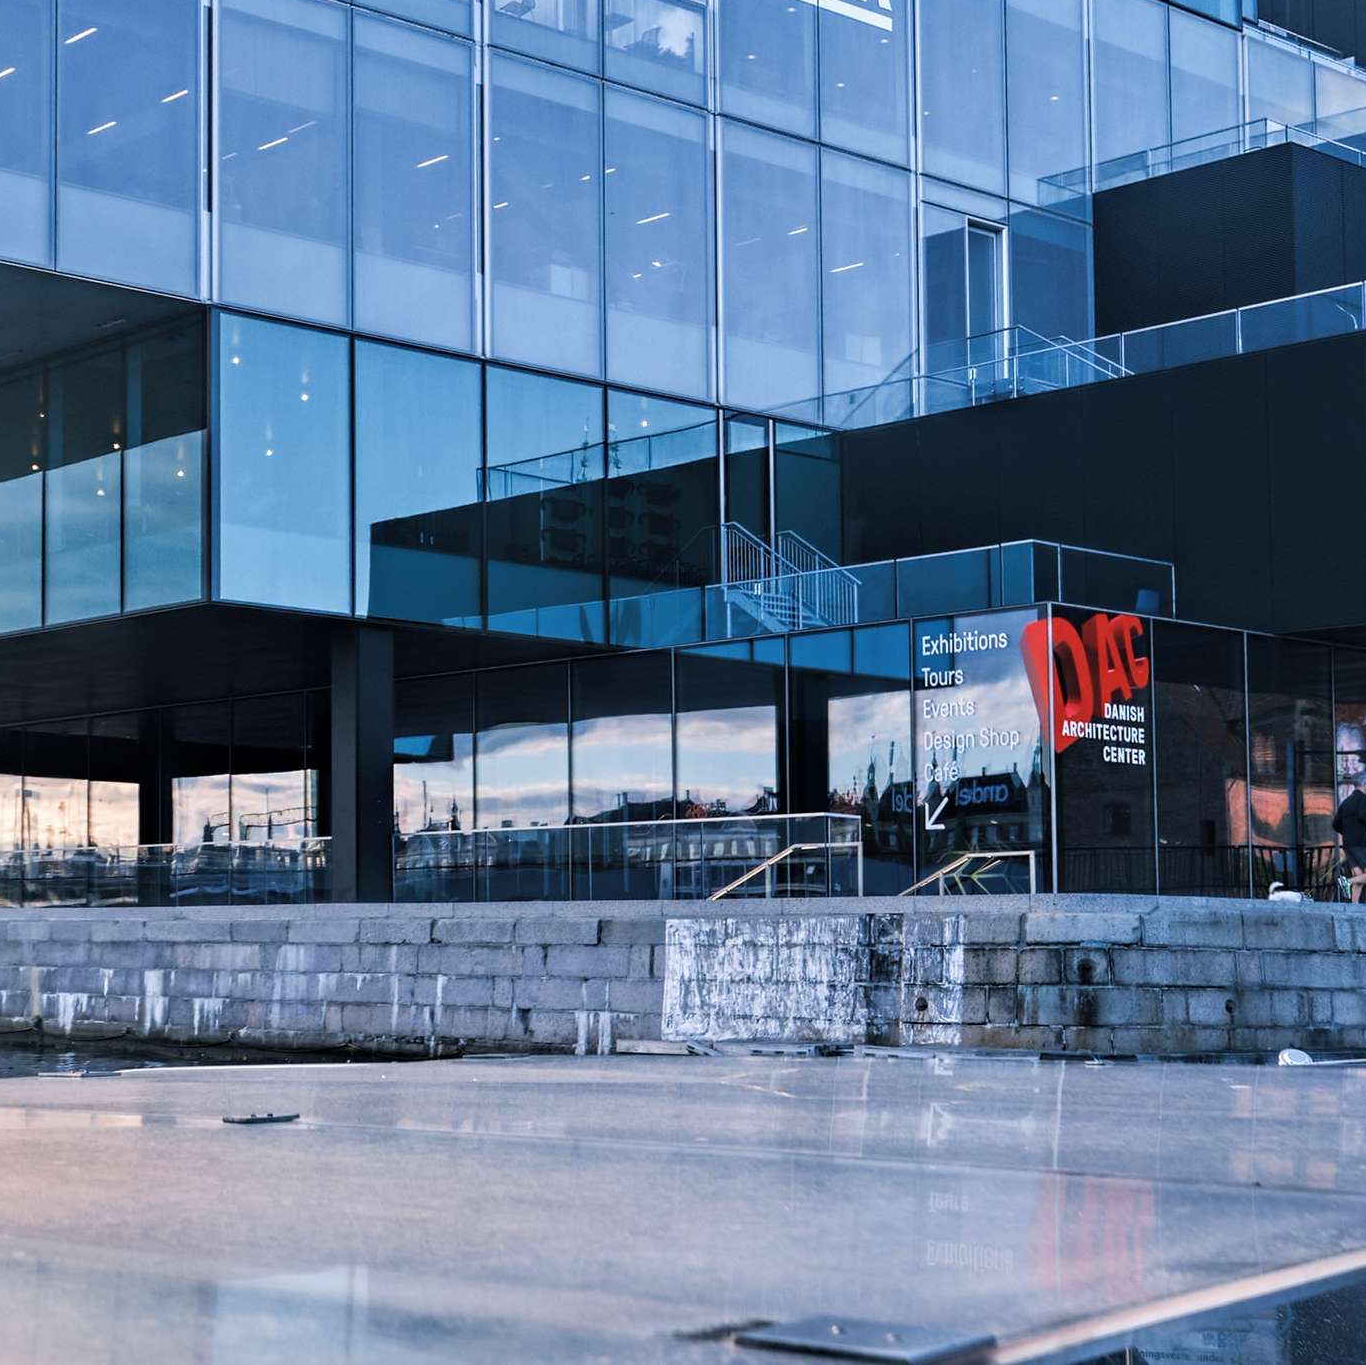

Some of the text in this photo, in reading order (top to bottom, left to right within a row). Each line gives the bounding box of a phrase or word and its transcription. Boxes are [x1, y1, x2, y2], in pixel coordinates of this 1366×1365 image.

[922, 631, 1008, 656] Exhibitions
[921, 667, 964, 687] Tours
[1019, 613, 1149, 754] DAC
[923, 697, 976, 719] Events
[1104, 703, 1145, 723] DANISH
[923, 727, 1020, 754] Design Shop
[1061, 720, 1146, 744] ARCHITECTURE
[1103, 746, 1146, 765] CENTER
[924, 761, 959, 782] Café
